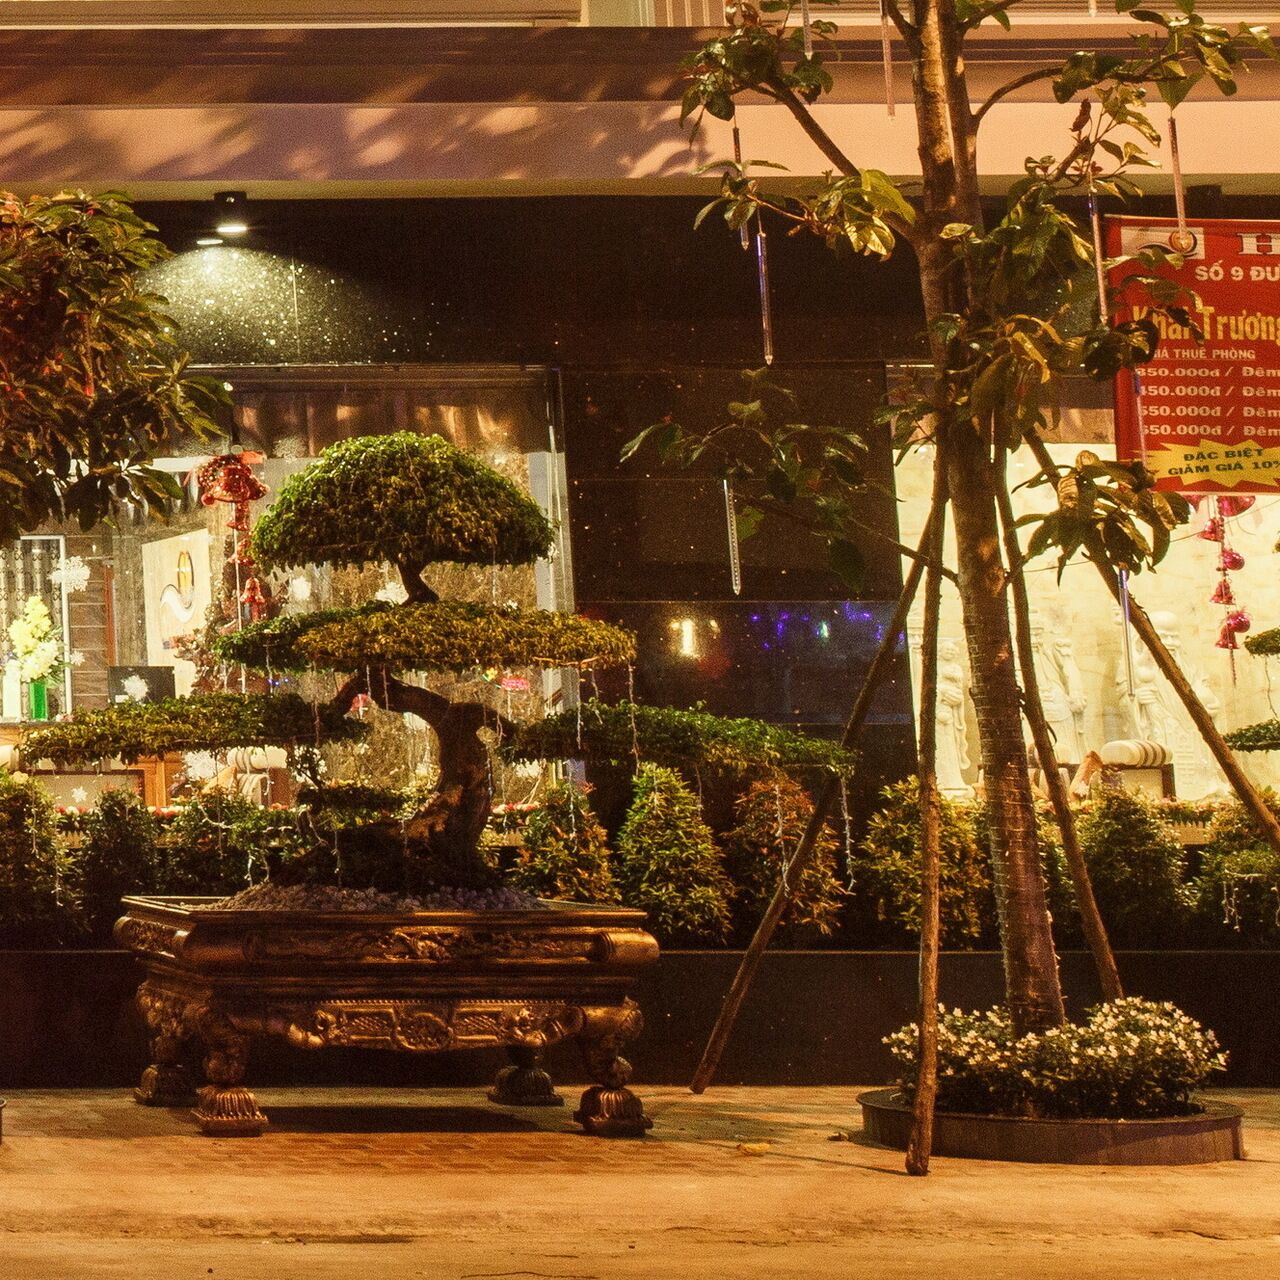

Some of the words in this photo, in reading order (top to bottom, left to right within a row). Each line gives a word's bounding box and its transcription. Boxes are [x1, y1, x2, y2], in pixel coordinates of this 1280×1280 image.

[1195, 260, 1224, 281] SỐ
[1230, 266, 1244, 281] 9
[1225, 447, 1264, 459] BIỆT
